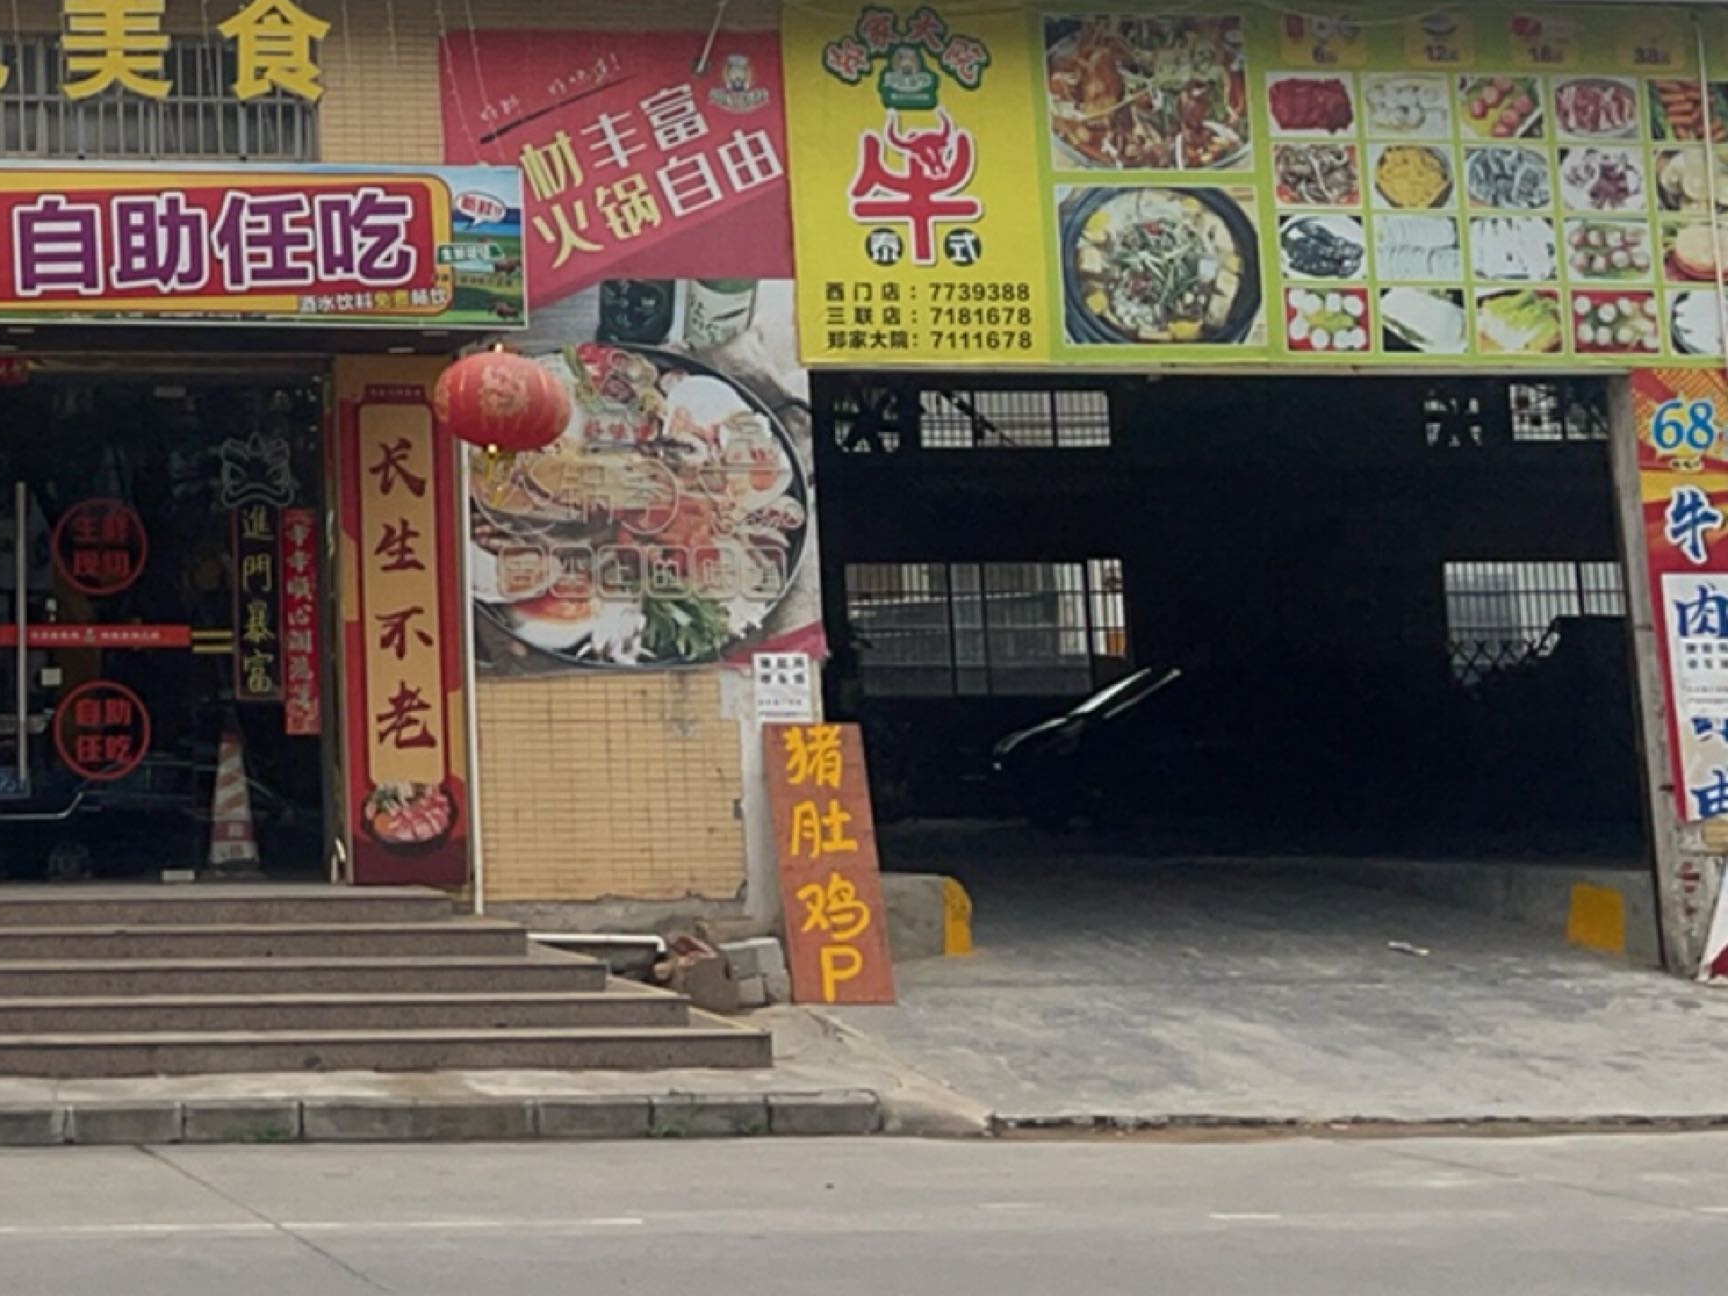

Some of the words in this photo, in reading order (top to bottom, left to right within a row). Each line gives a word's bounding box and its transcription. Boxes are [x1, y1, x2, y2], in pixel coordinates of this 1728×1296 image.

[530, 128, 785, 270] 火锅自由
[10, 188, 417, 298] 自助任吃
[929, 281, 1030, 302] 7739388
[930, 306, 1032, 326] 7181678
[930, 329, 1032, 350] 7111678
[1653, 401, 1715, 450] 68
[368, 438, 438, 751] 长生不老
[75, 698, 132, 726] 自助
